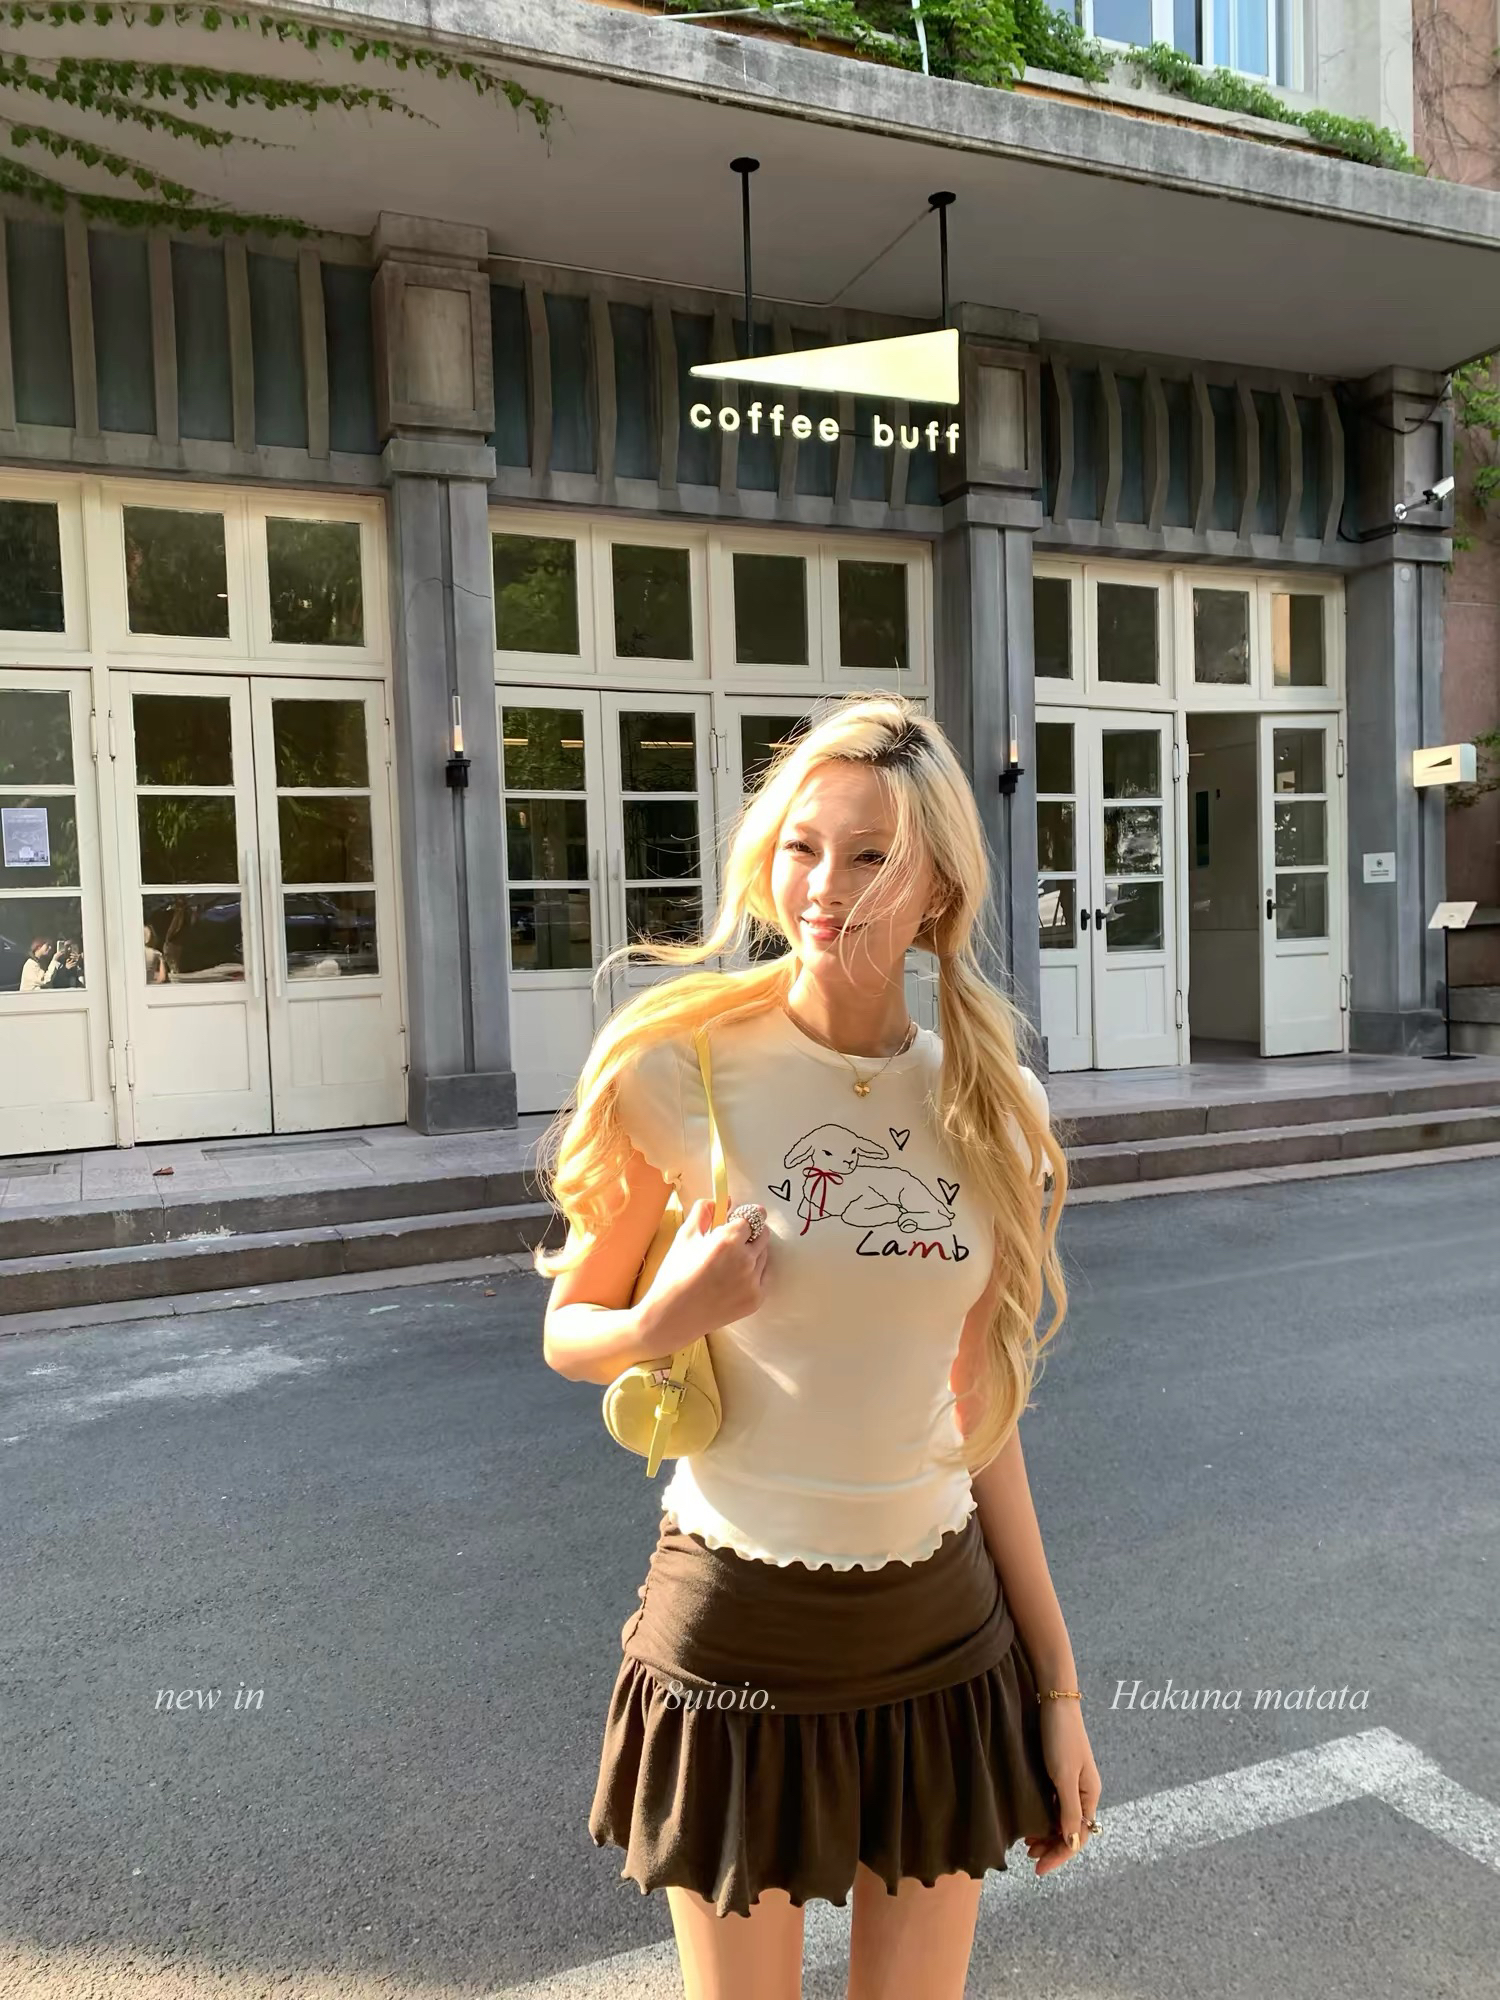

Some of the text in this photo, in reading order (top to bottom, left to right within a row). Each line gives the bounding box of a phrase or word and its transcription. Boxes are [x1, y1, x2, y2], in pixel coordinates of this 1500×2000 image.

[689, 402, 960, 454] coffee buff
[856, 1230, 970, 1262] Lamb
